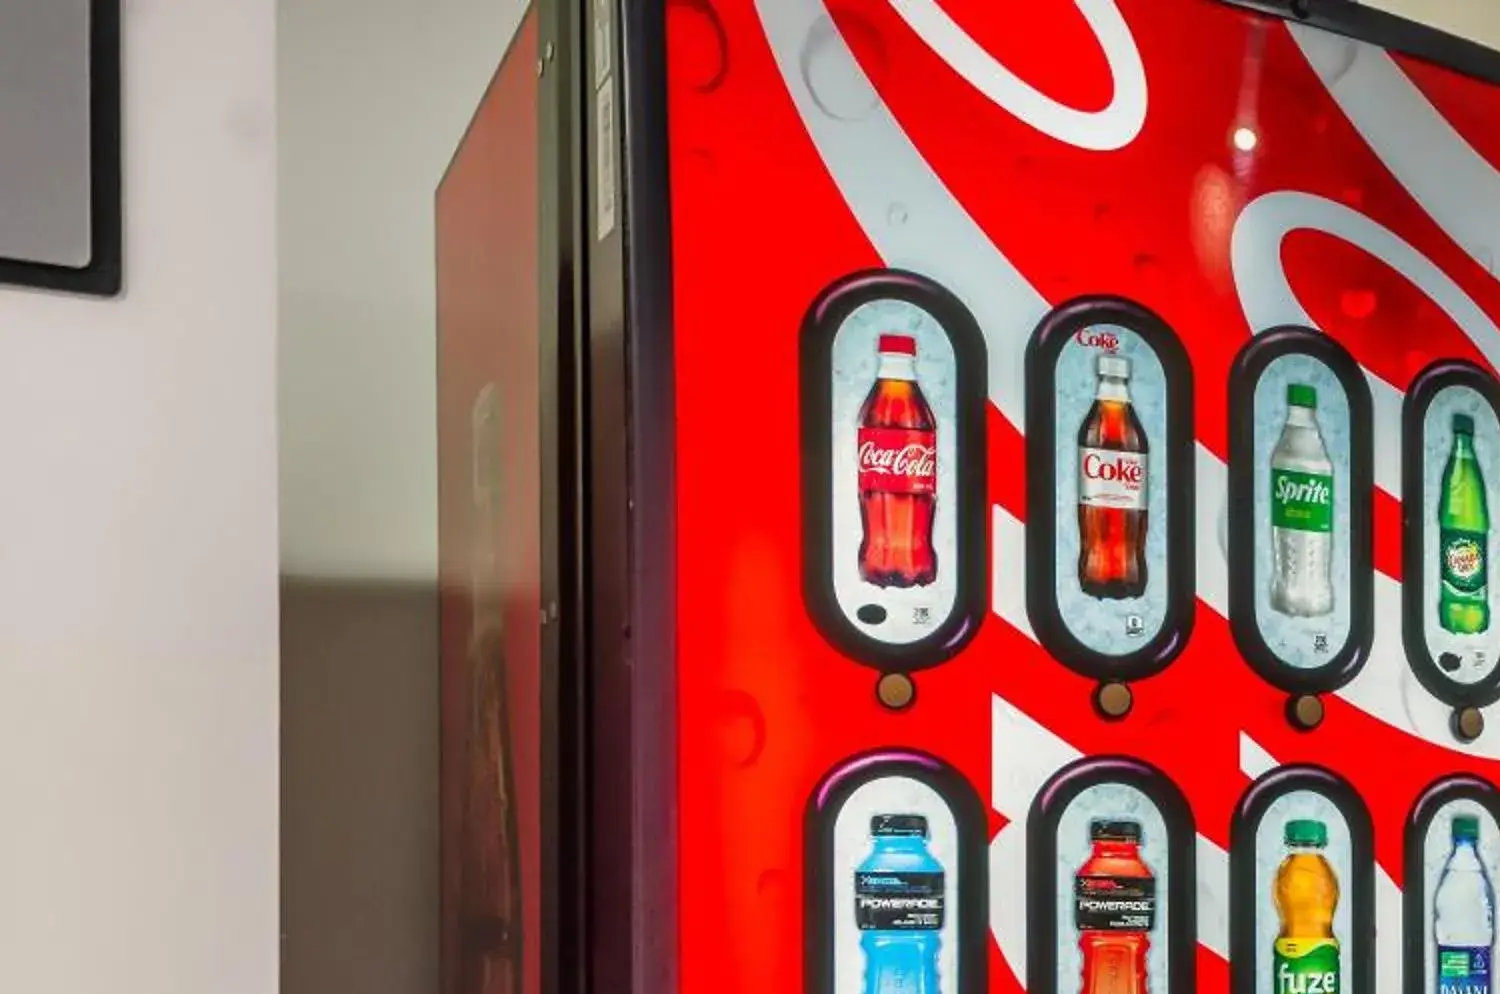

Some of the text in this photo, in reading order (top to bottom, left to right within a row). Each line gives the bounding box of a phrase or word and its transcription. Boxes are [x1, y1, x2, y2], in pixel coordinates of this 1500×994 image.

[859, 441, 936, 477] Coca-Cola
[1083, 453, 1142, 482] Coke
[1275, 475, 1329, 505] Sprite
